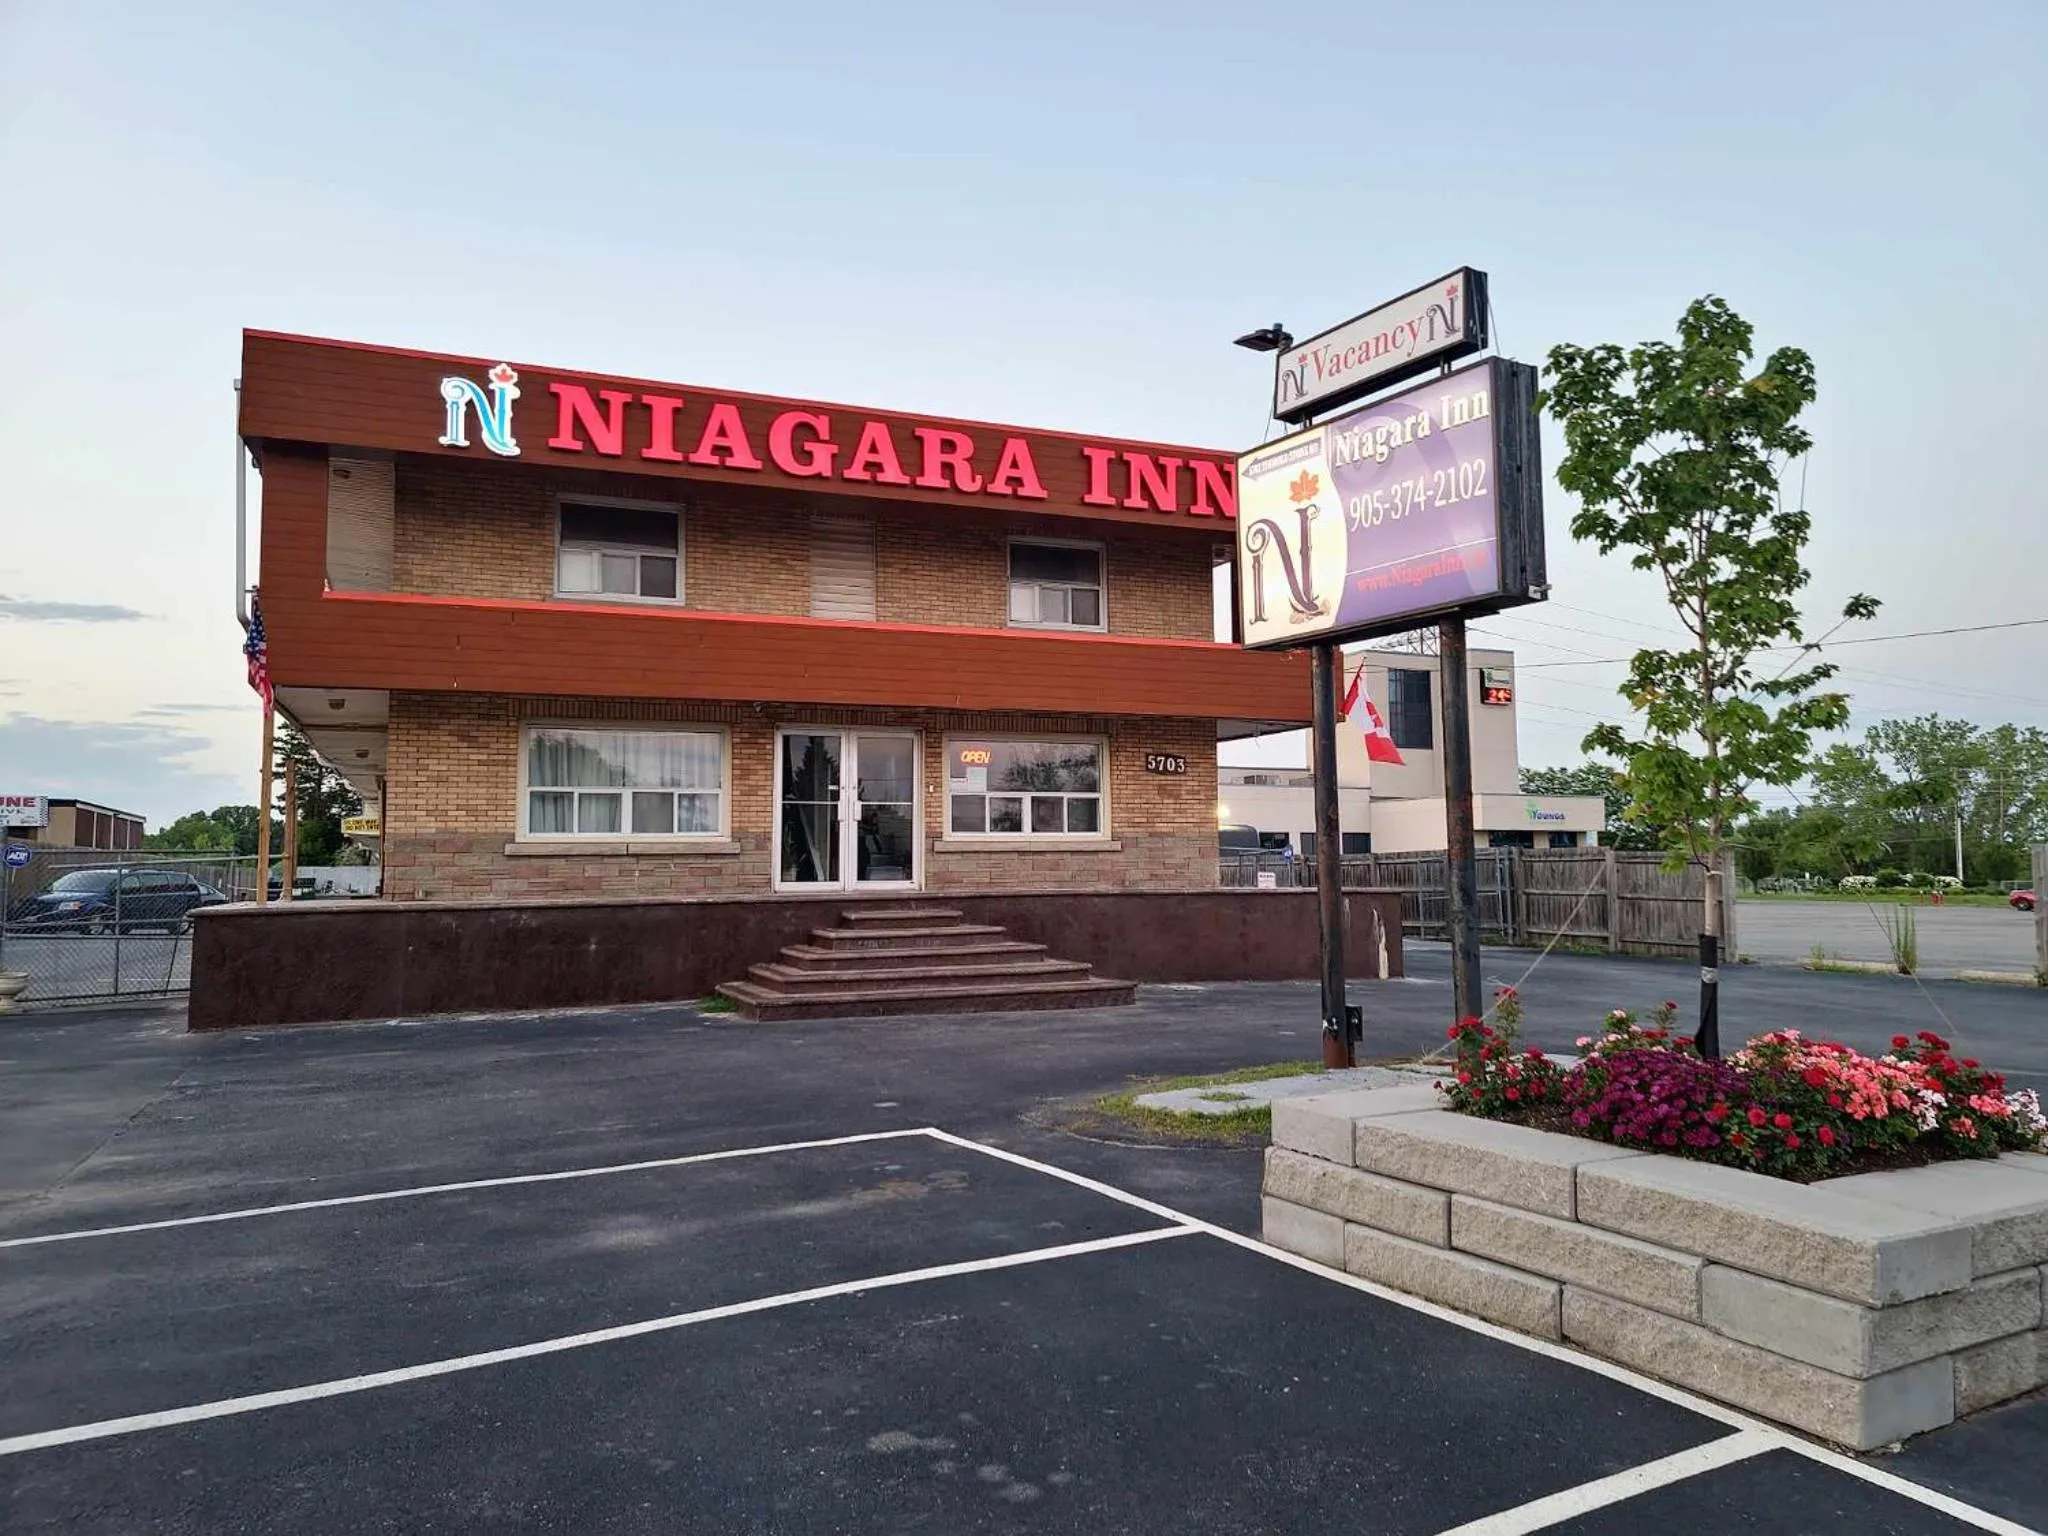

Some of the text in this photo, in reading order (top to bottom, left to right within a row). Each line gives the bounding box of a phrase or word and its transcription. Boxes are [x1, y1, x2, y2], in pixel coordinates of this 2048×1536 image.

[1312, 315, 1425, 382] Vacancy
[547, 382, 1049, 499] NIAGARA
[1083, 447, 1237, 518] INN
[1335, 410, 1432, 468] Niagara
[1440, 390, 1490, 432] Inn
[1350, 458, 1488, 532] 905-374-2102
[960, 750, 991, 764] OPEN
[1147, 755, 1185, 773] 5703
